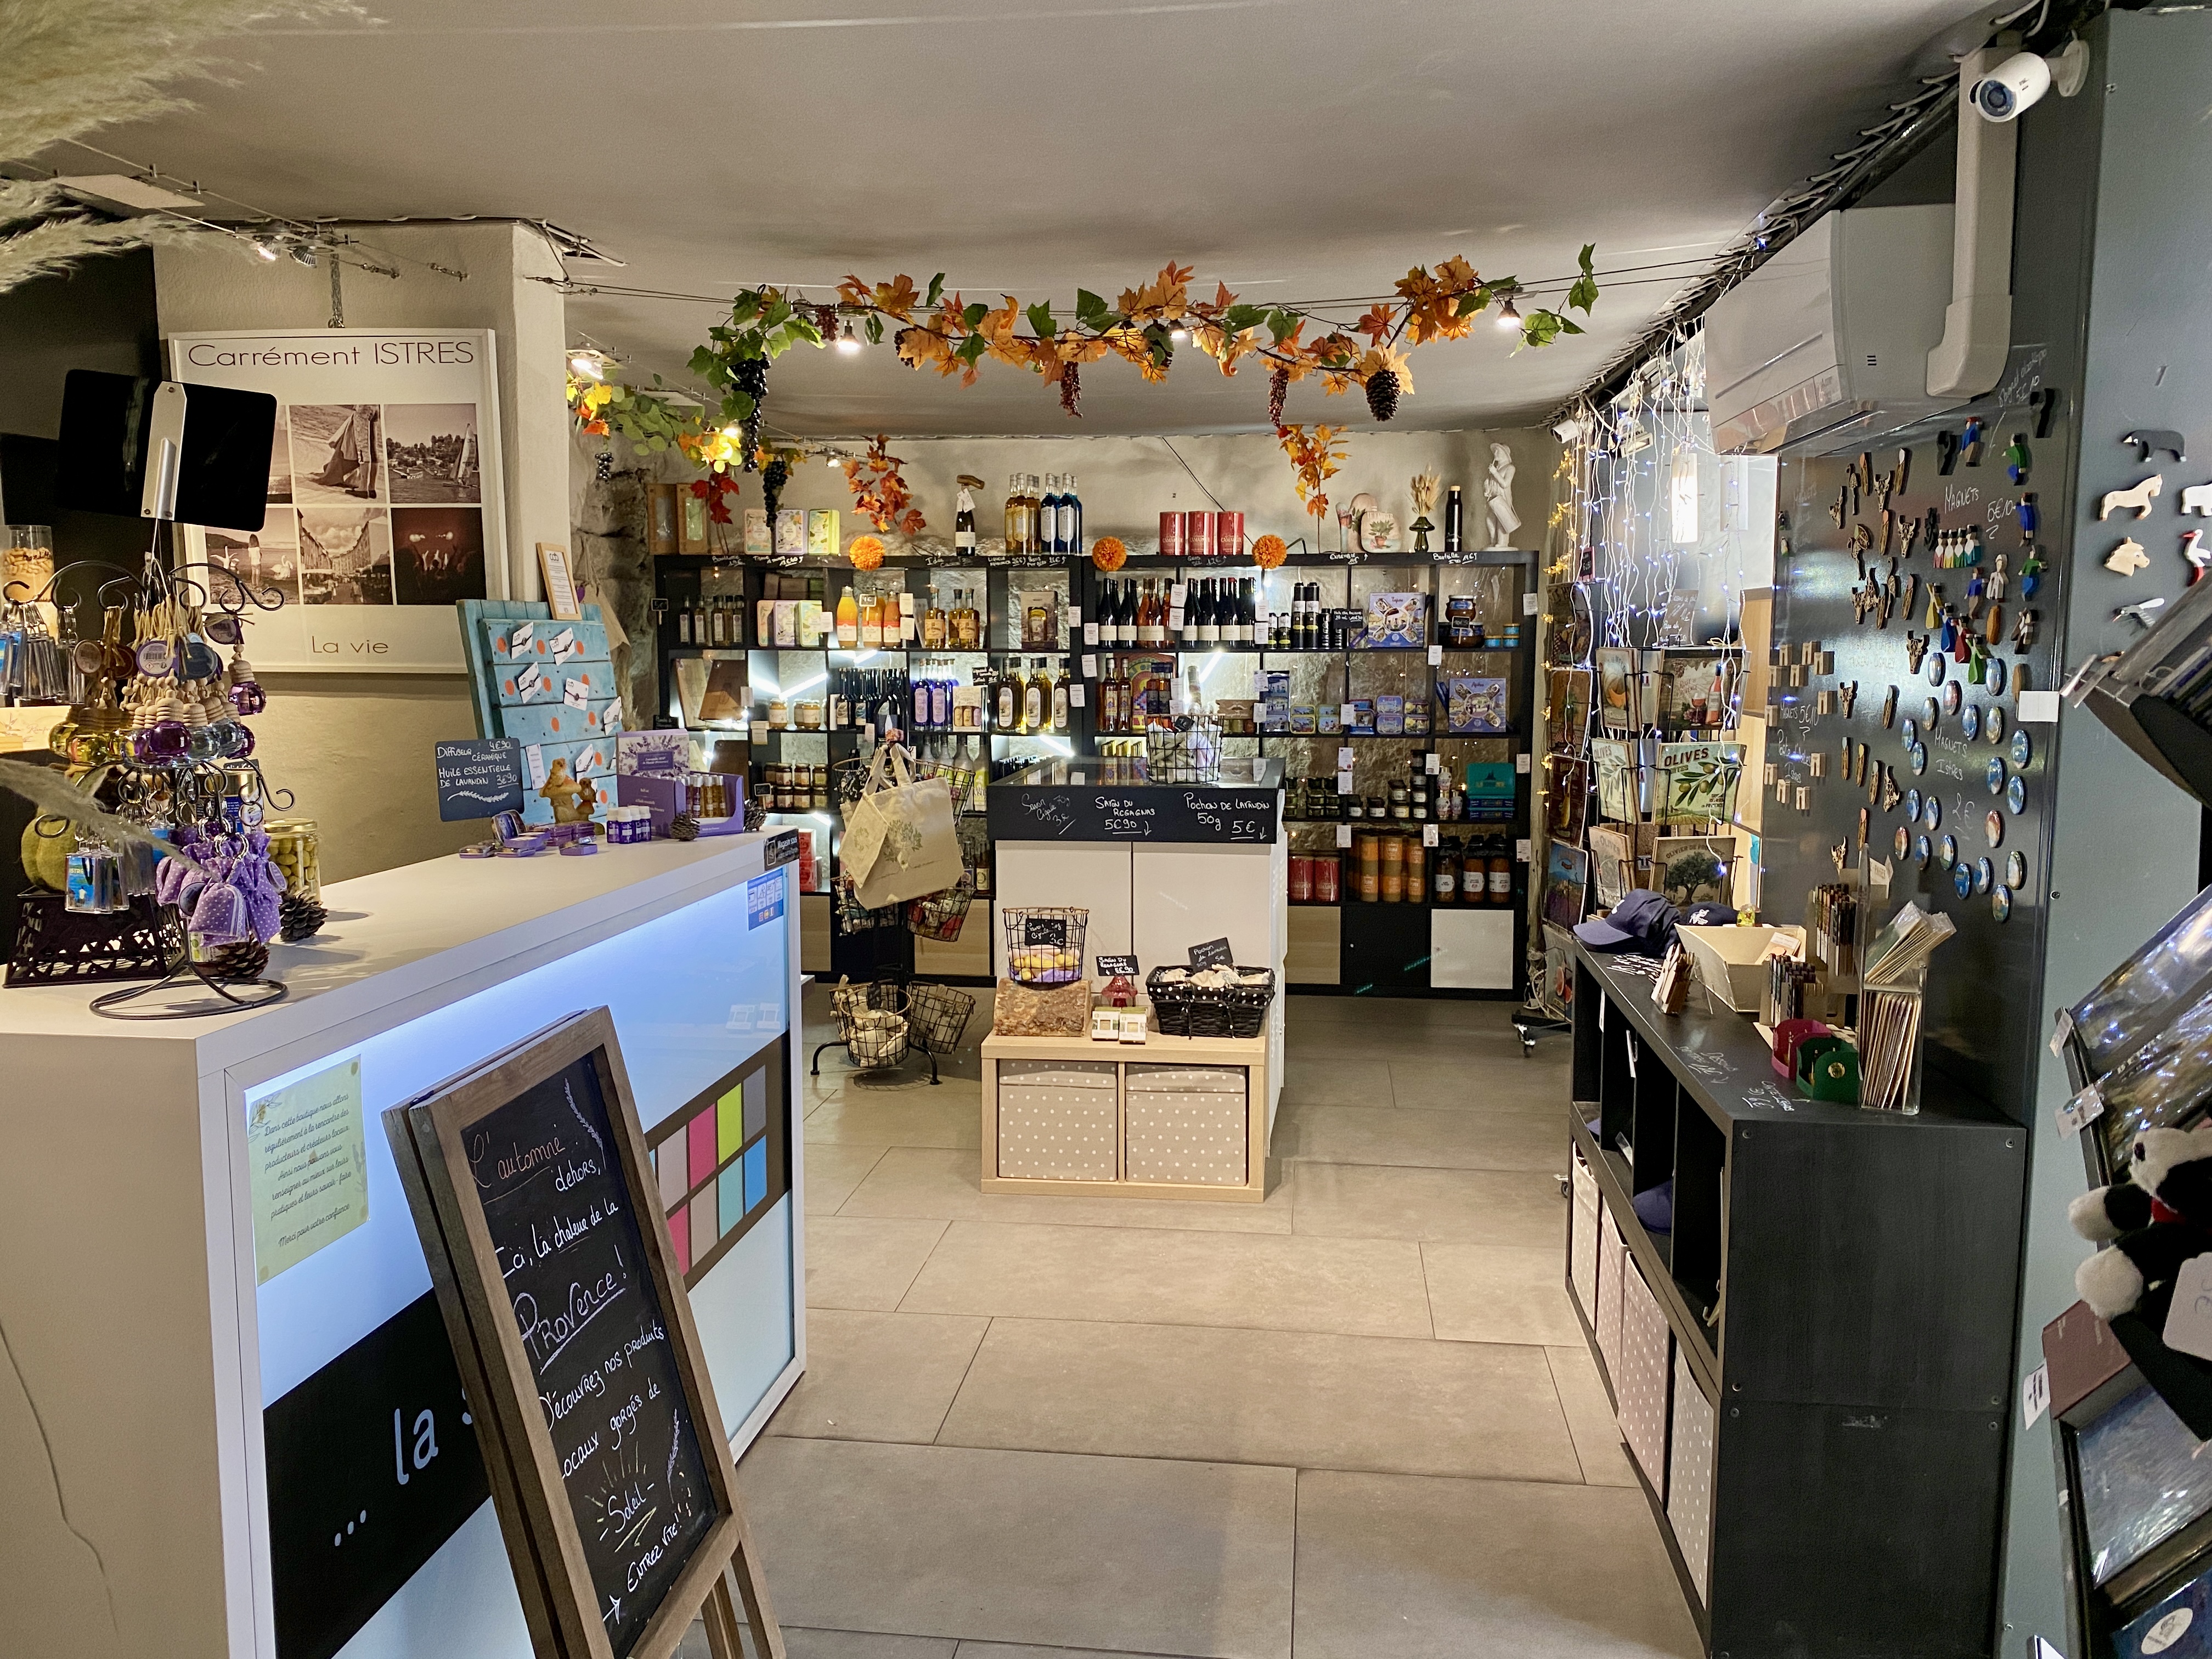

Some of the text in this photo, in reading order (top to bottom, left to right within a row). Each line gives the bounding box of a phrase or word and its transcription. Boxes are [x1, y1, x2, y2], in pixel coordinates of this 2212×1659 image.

[189, 342, 474, 366] Carrément ISTRES
[312, 636, 388, 653] La vie
[438, 764, 511, 778] HUILE ESSENTIELLE
[1664, 747, 1709, 768] OLIVES
[440, 779, 451, 788] DE
[1197, 812, 1221, 831] 50g
[1220, 802, 1232, 810] DE
[264, 1093, 349, 1136] Dans cette boutique nous allons
[264, 1108, 349, 1154] régulièrement à la rencontre des
[264, 1125, 350, 1174] producteurs et créateurs locaux
[278, 1144, 342, 1181] Ainsi nous pouvons vous
[272, 1181, 301, 1200] renseigner
[309, 1169, 325, 1181] mieux
[335, 1156, 349, 1169] leurs
[555, 1159, 601, 1192] dehors,
[270, 1199, 298, 1222] pratiques
[298, 1193, 303, 1204] et
[304, 1188, 318, 1200] leurs
[278, 1204, 350, 1248] Merci pour votre confiance
[531, 1223, 552, 1258] la
[590, 1205, 602, 1226] de
[603, 1197, 618, 1216] la
[605, 1351, 623, 1374] nos
[624, 1319, 664, 1368] produits
[394, 1408, 439, 1485] la
[562, 1376, 661, 1480] ocaux gorgés de
[607, 1481, 647, 1534] Soleil
[627, 1544, 664, 1593] Entrez
